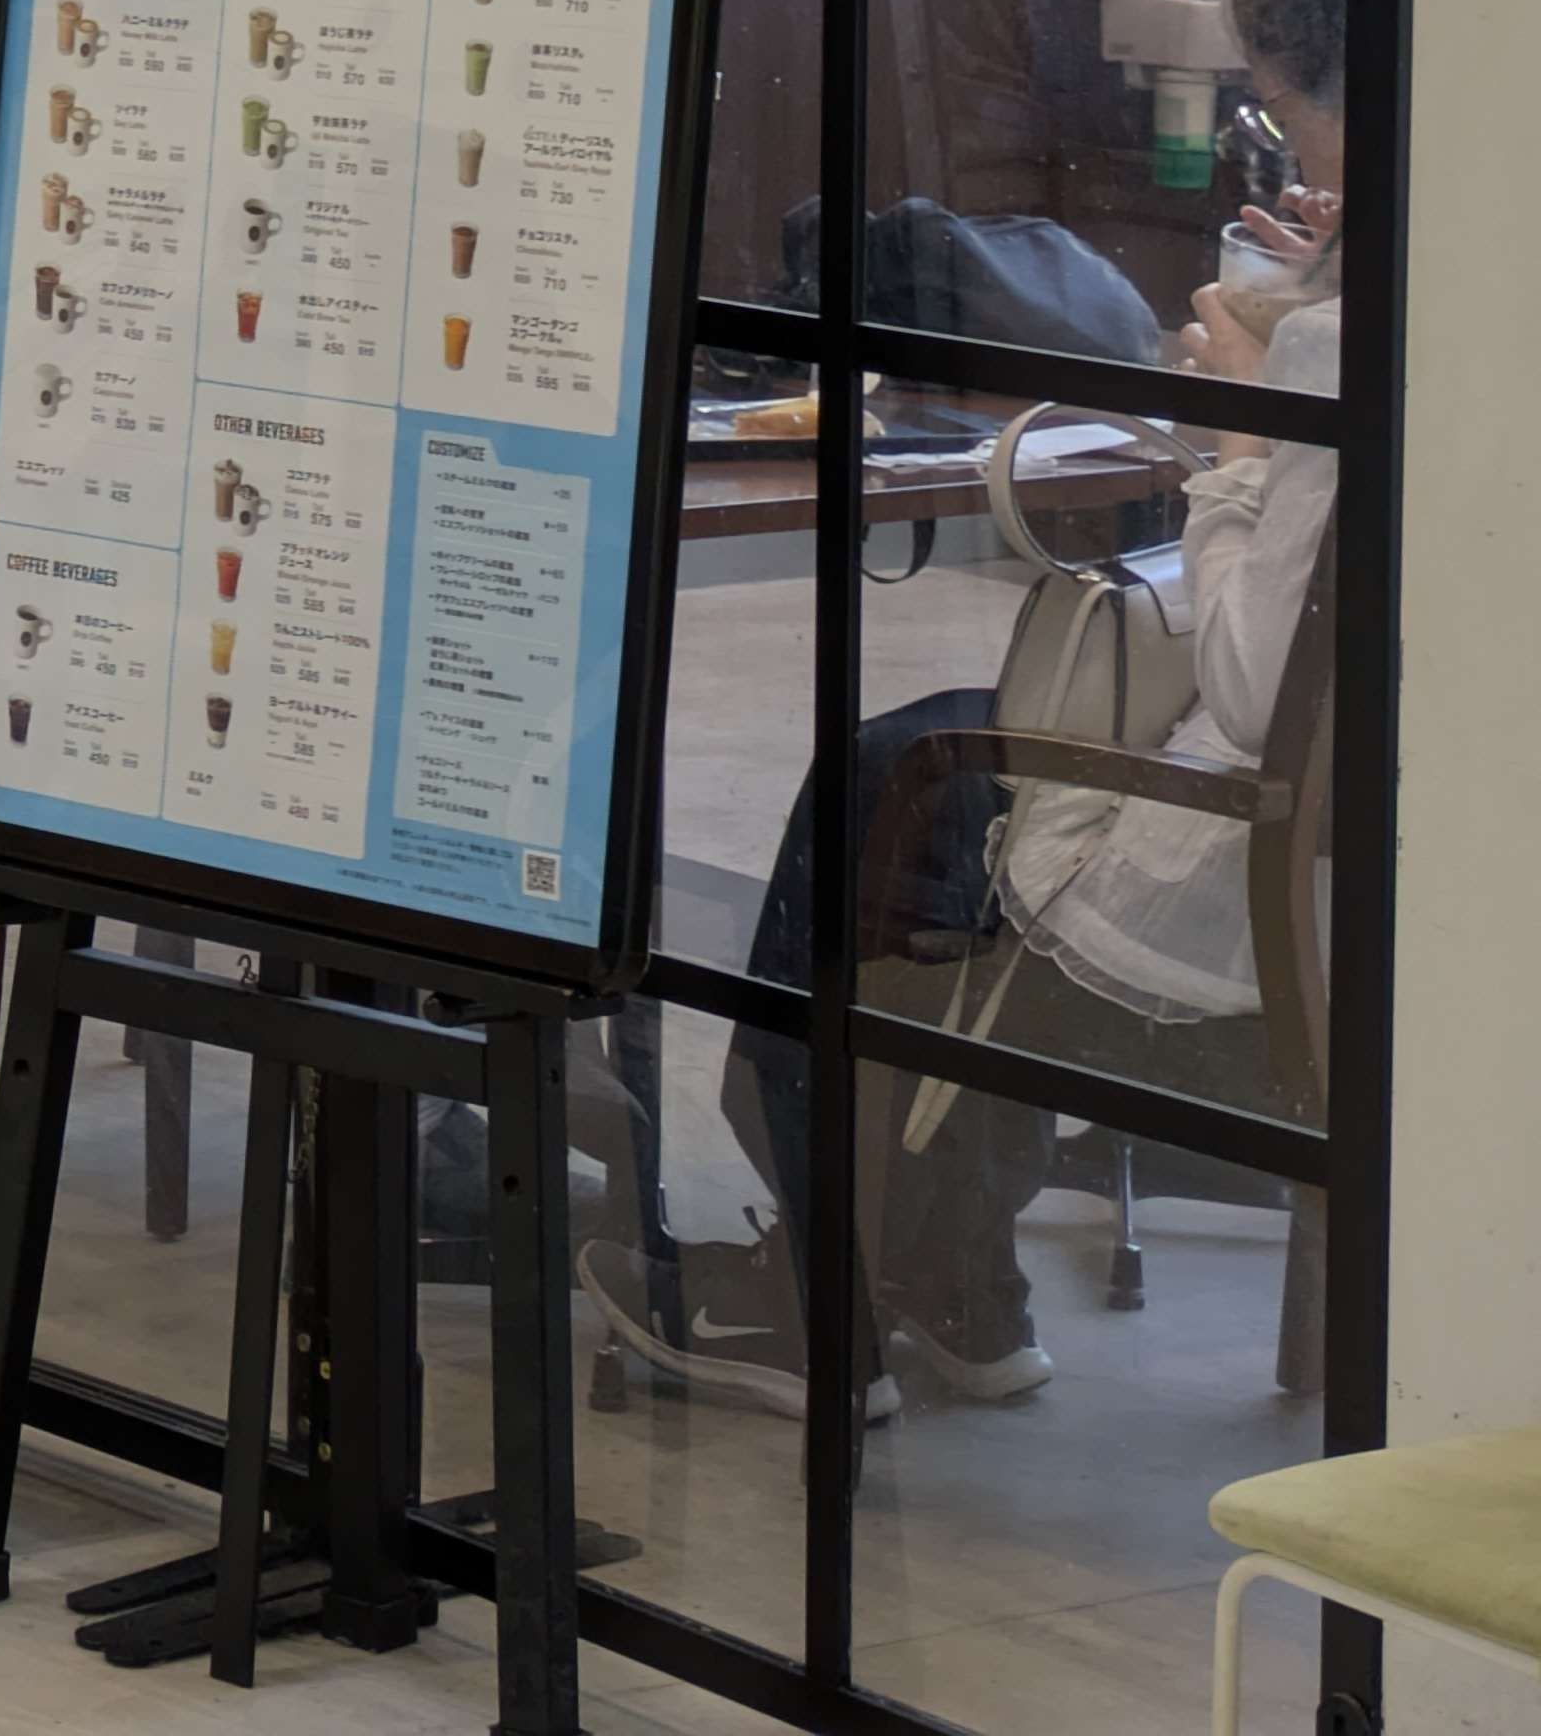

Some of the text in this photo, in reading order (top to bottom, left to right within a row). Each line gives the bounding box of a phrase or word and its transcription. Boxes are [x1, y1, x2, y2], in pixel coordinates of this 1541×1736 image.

[214, 414, 325, 445] OTHER BEVERAGES
[7, 553, 118, 587] COFFEE BEVERAGES
